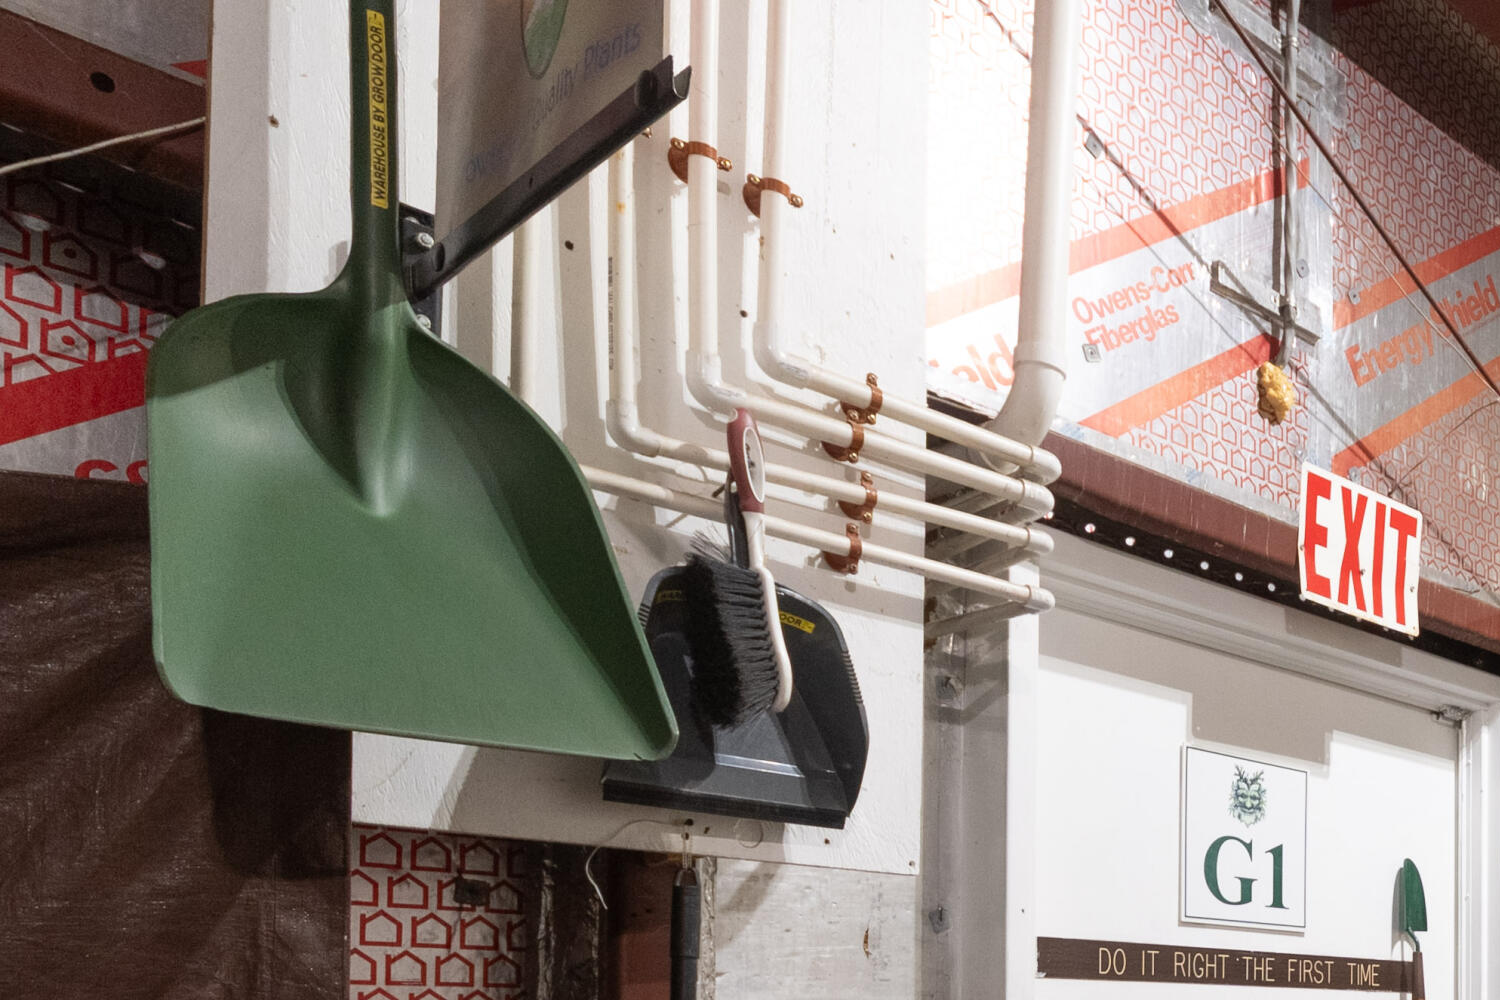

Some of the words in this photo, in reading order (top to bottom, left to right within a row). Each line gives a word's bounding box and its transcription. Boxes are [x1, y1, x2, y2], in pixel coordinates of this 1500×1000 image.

[369, 25, 383, 63] DOOR
[370, 65, 385, 104] GROW
[371, 109, 385, 123] BY
[372, 124, 387, 201] WAREHOUSE
[1084, 303, 1181, 353] Fiberglas
[1344, 316, 1435, 388] Energy
[1304, 471, 1418, 626] EXIT
[1203, 835, 1290, 910] G1
[1098, 947, 1128, 976] DO
[1141, 949, 1161, 977] IT
[1173, 951, 1230, 980] RIGHT
[1242, 955, 1276, 983] THE
[1287, 957, 1335, 985] FIRST
[1346, 961, 1381, 987] TIME
